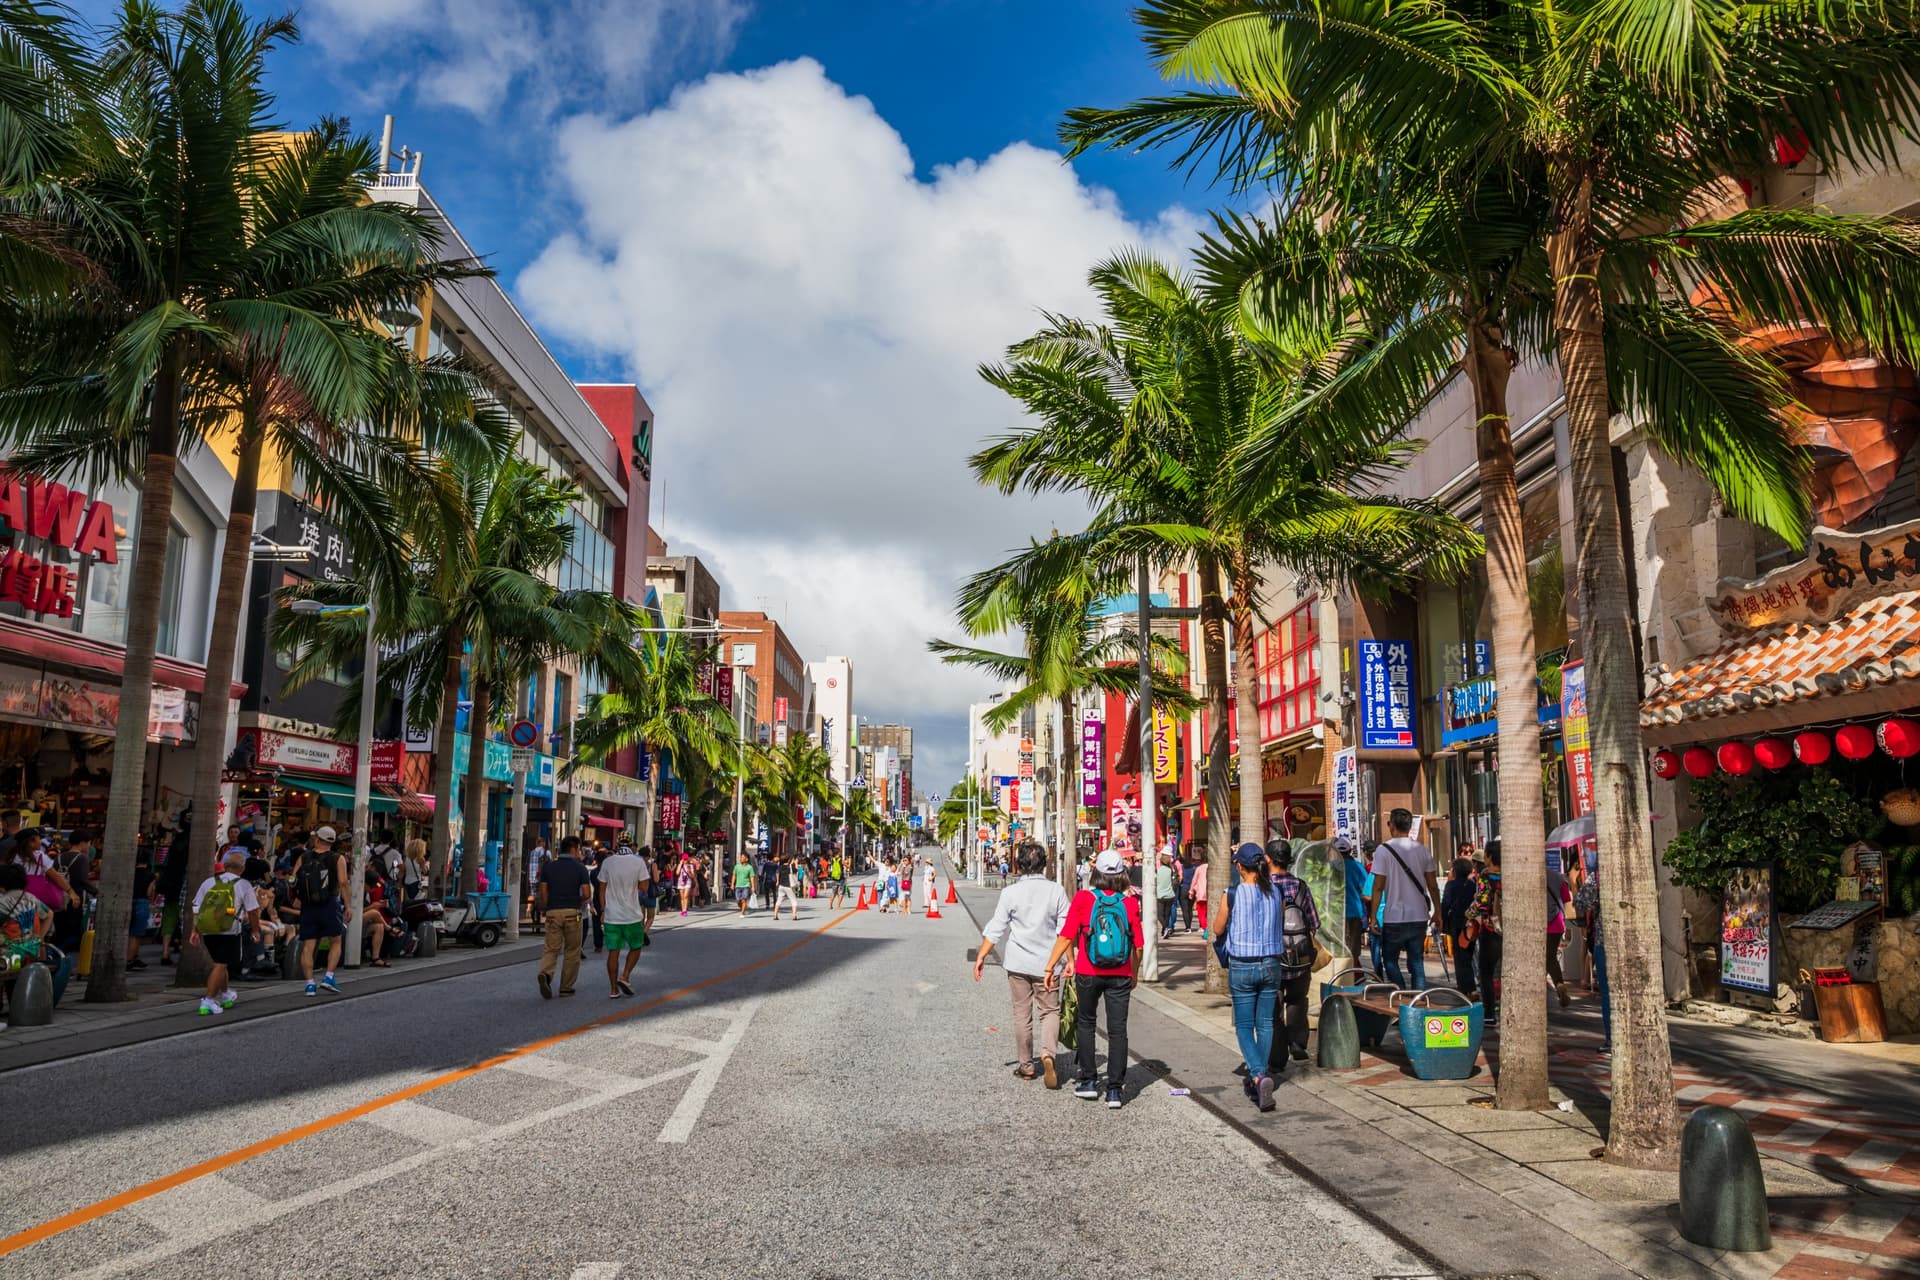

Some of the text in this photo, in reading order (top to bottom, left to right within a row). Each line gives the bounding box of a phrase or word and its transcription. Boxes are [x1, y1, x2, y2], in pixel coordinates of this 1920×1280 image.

[299, 517, 353, 568] 焼肉
[1365, 663, 1373, 695] Exchange
[1388, 644, 1409, 728] 外貨両替
[1085, 726, 1096, 795] 御菓子御殿
[1374, 737, 1411, 745] Travelex
